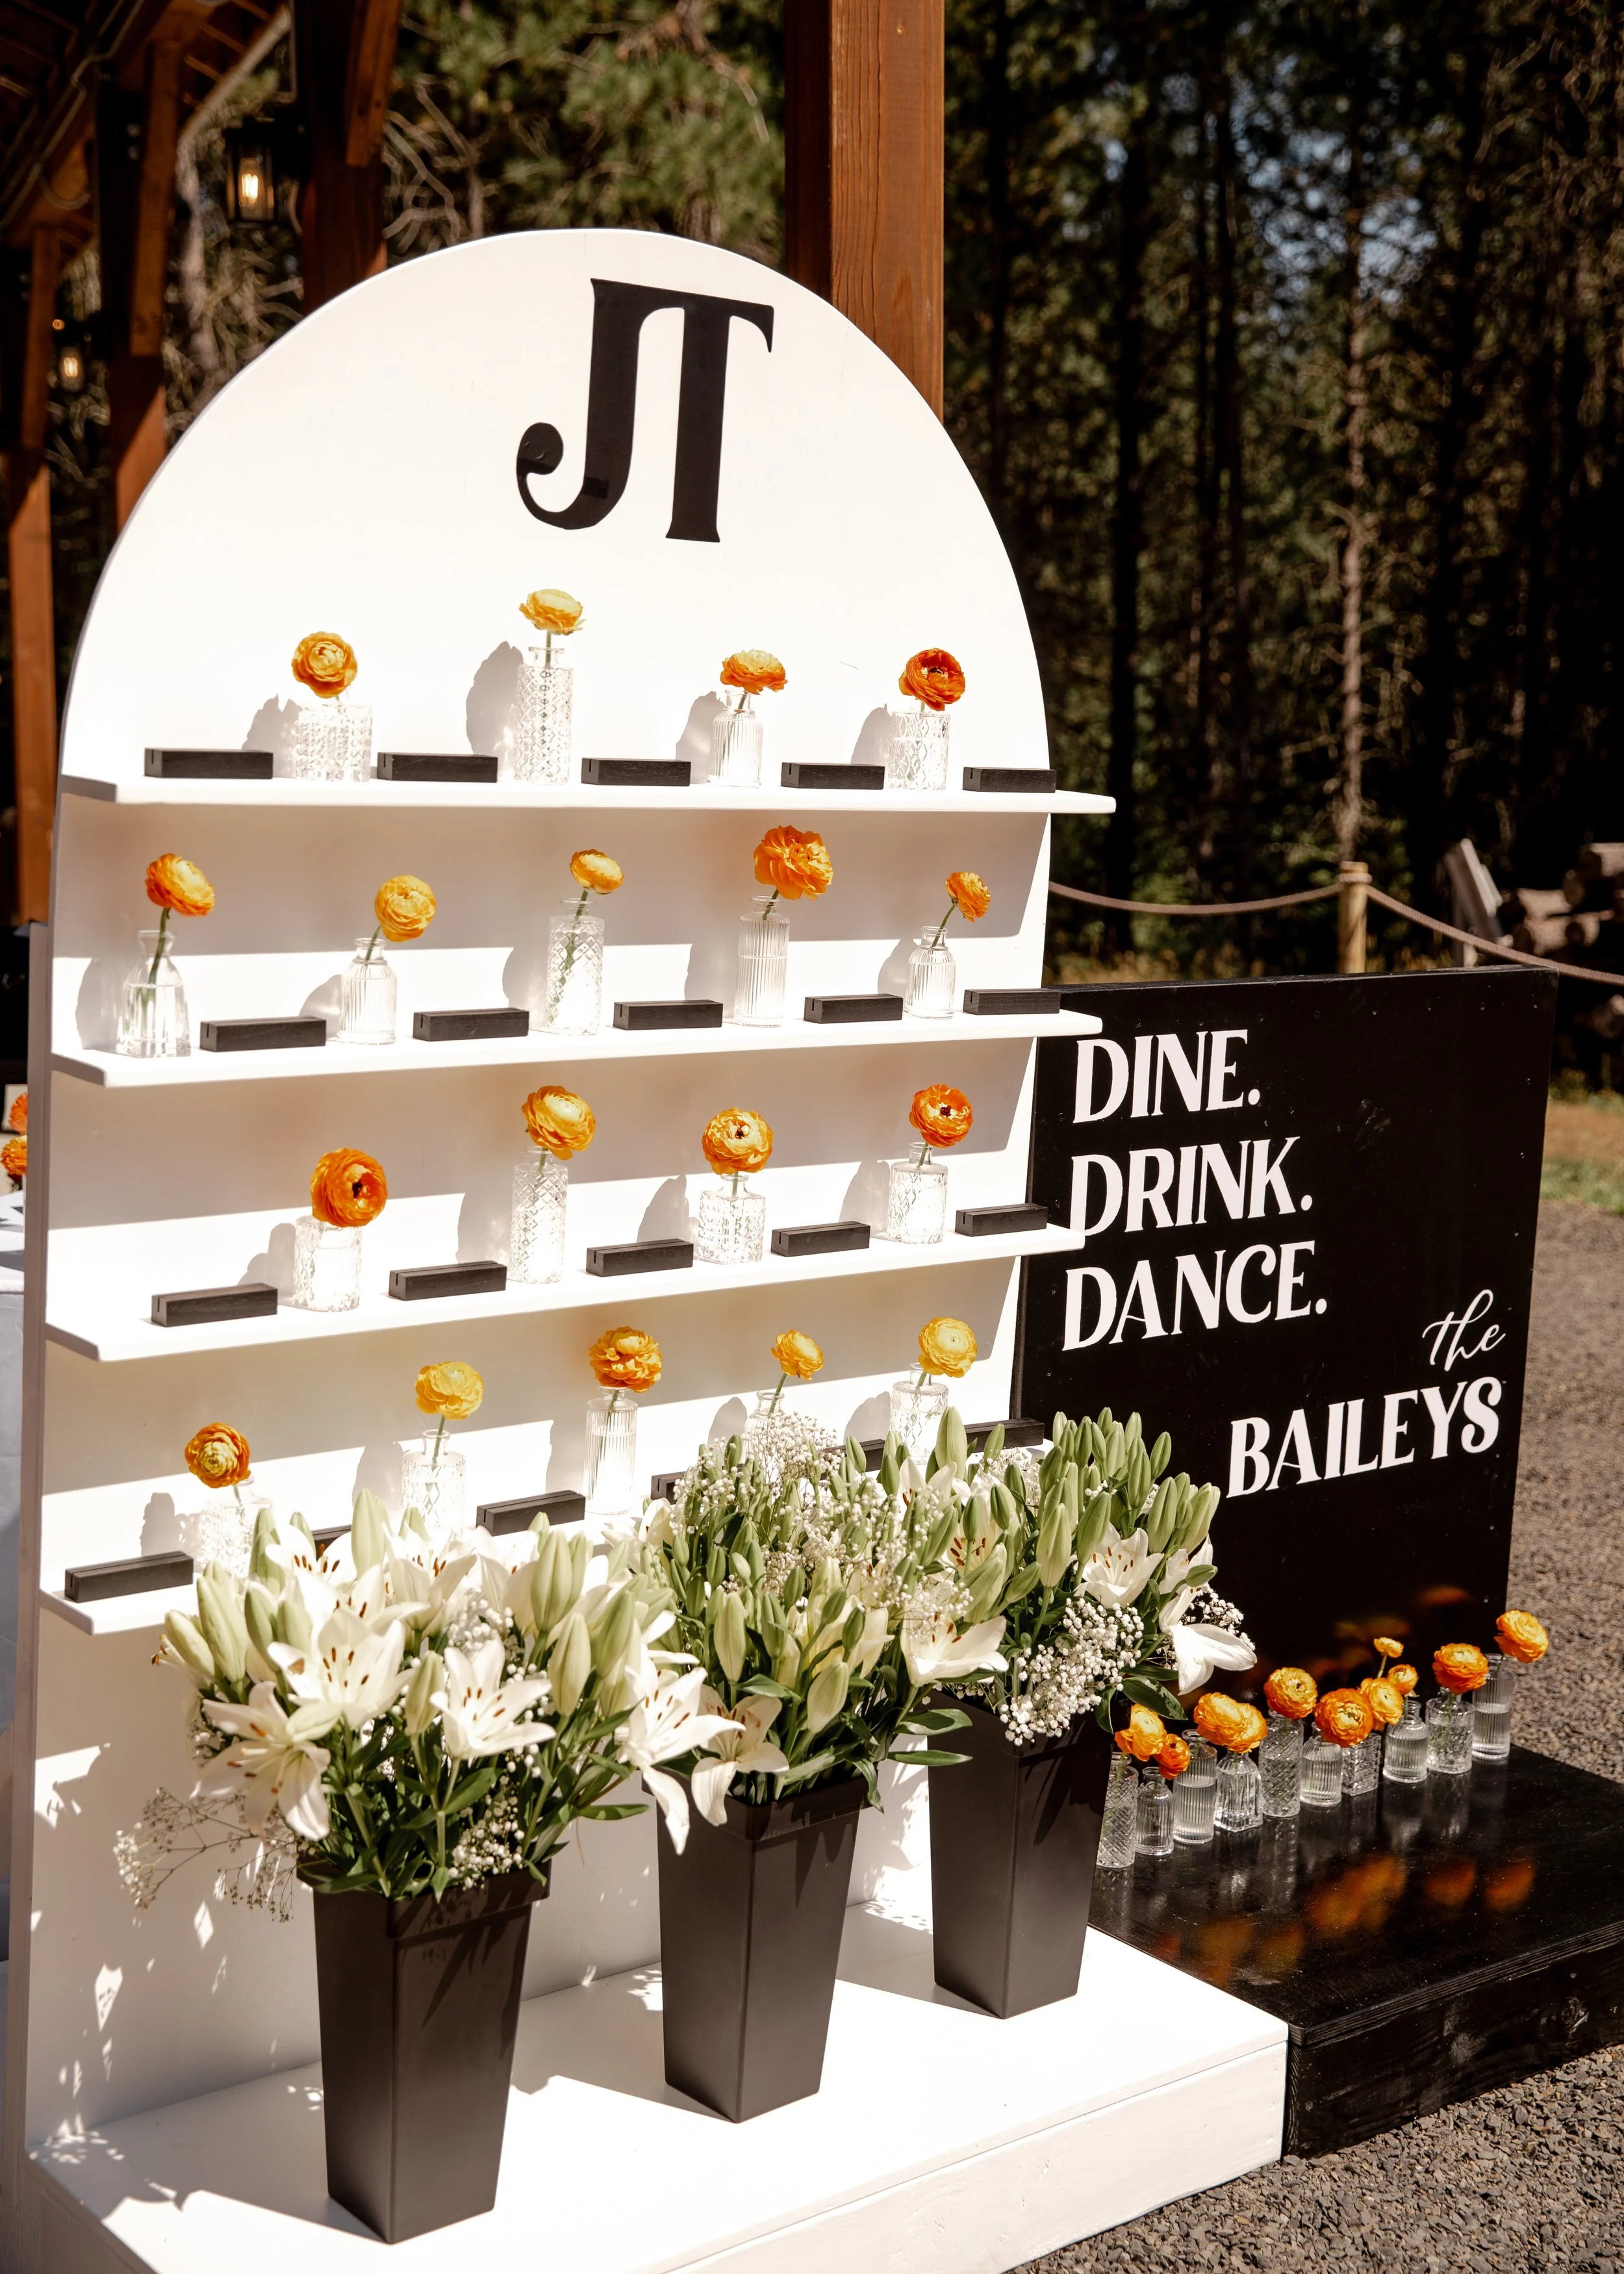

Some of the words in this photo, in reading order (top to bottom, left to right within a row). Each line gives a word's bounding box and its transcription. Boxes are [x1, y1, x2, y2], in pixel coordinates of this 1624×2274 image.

[516, 278, 774, 543] JT
[1072, 1029, 1261, 1124] DINE.
[1069, 1136, 1313, 1237] DRINK.
[1061, 1240, 1328, 1352] DANCE.
[1422, 1289, 1506, 1372] the
[1226, 1376, 1503, 1499] BAILEYS
